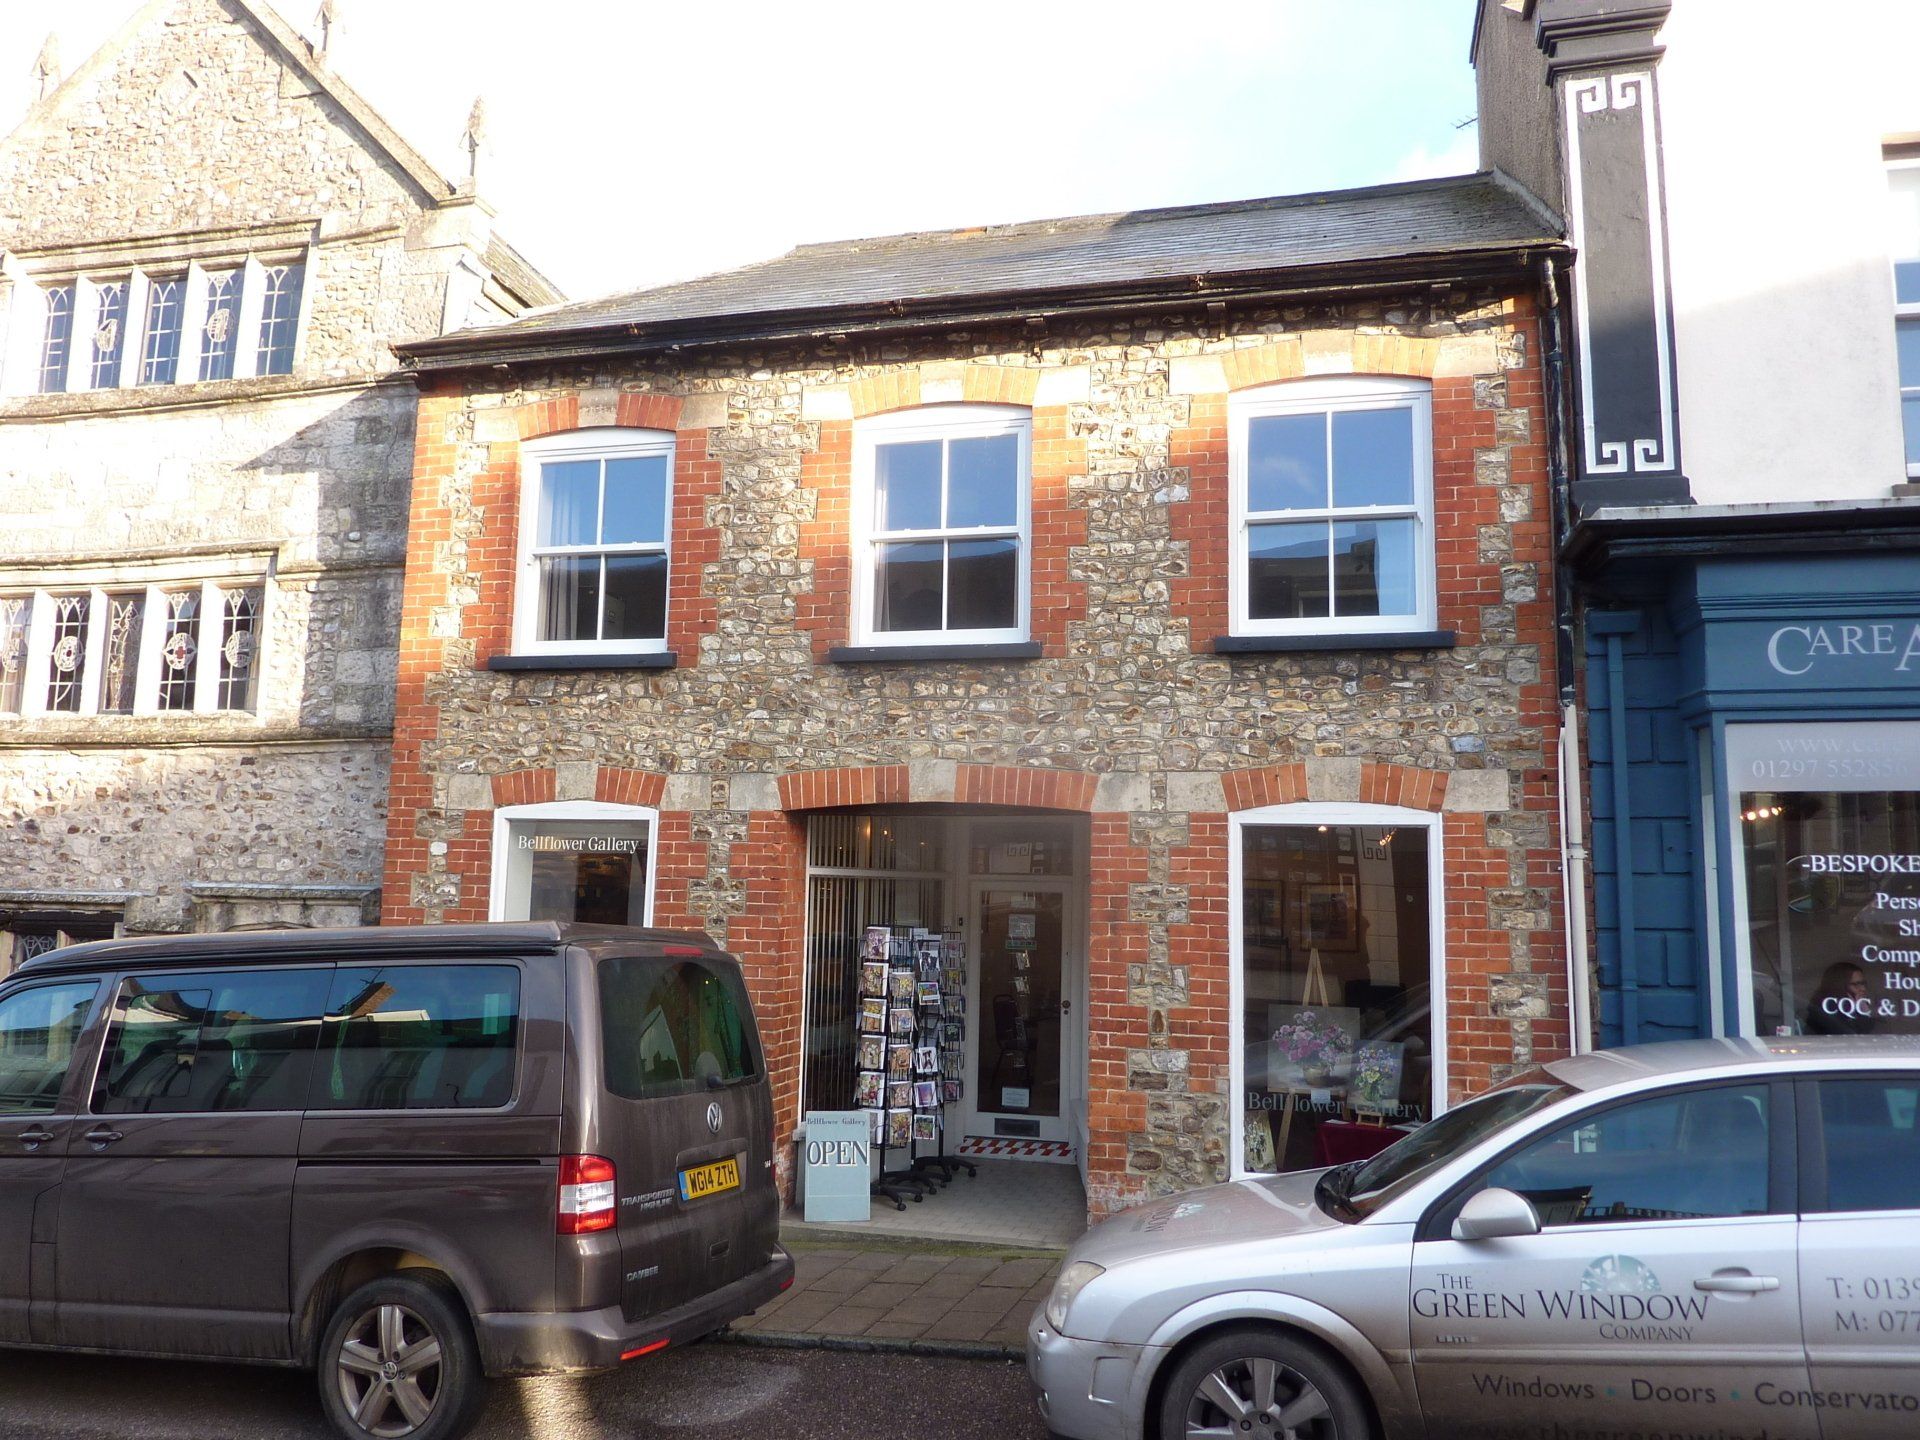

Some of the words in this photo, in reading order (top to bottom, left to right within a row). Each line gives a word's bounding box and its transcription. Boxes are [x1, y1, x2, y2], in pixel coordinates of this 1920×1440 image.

[1751, 759, 1819, 778] 01297
[518, 835, 585, 850] Bellflower
[588, 836, 639, 854] Gallery
[1875, 893, 1920, 910] Pers
[1861, 945, 1920, 968] Comp
[1822, 997, 1872, 1019] CQC
[1877, 999, 1897, 1017] &
[1248, 1092, 1344, 1114] Belllower
[806, 1140, 870, 1167] OPEN
[689, 1167, 715, 1194] WG14
[715, 1163, 735, 1187] ZTH
[621, 1188, 675, 1207] TRANSPORTER
[1436, 1273, 1473, 1290] THE
[1826, 1277, 1853, 1299] T:
[1413, 1288, 1526, 1319] GREEN
[1535, 1289, 1711, 1321] WINDOW
[1600, 1322, 1694, 1341] COMPANY
[1836, 1310, 1868, 1332] M:
[1472, 1373, 1595, 1400] Windows
[1631, 1378, 1717, 1403] Doors
[1755, 1382, 1919, 1411] Conservato
